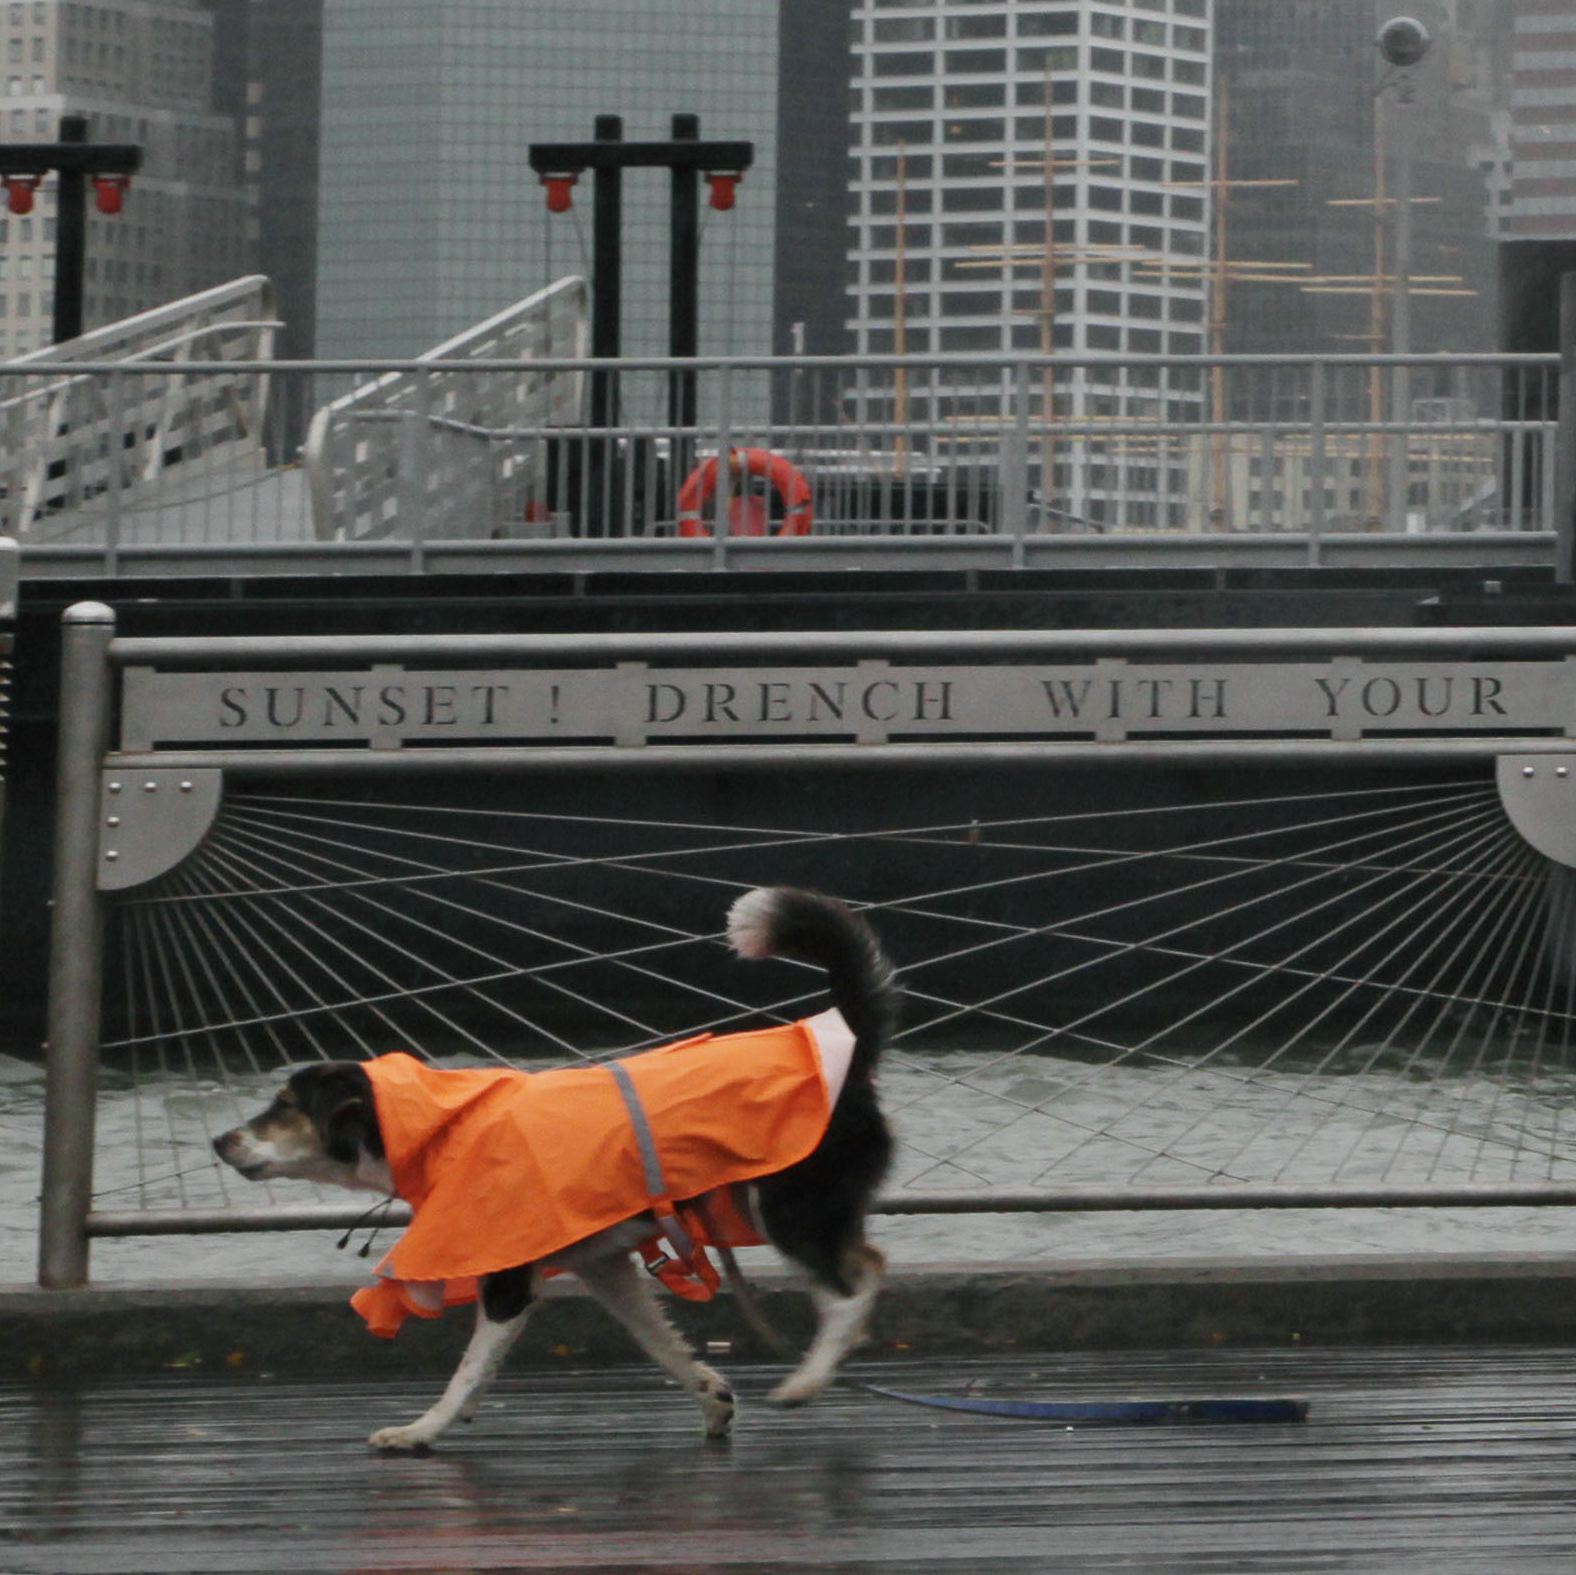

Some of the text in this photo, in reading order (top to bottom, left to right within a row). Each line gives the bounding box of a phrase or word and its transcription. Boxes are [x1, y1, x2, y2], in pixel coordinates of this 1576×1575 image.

[644, 678, 955, 724] DRENCH
[1041, 678, 1230, 720] WITH
[1314, 676, 1511, 717] YOUR
